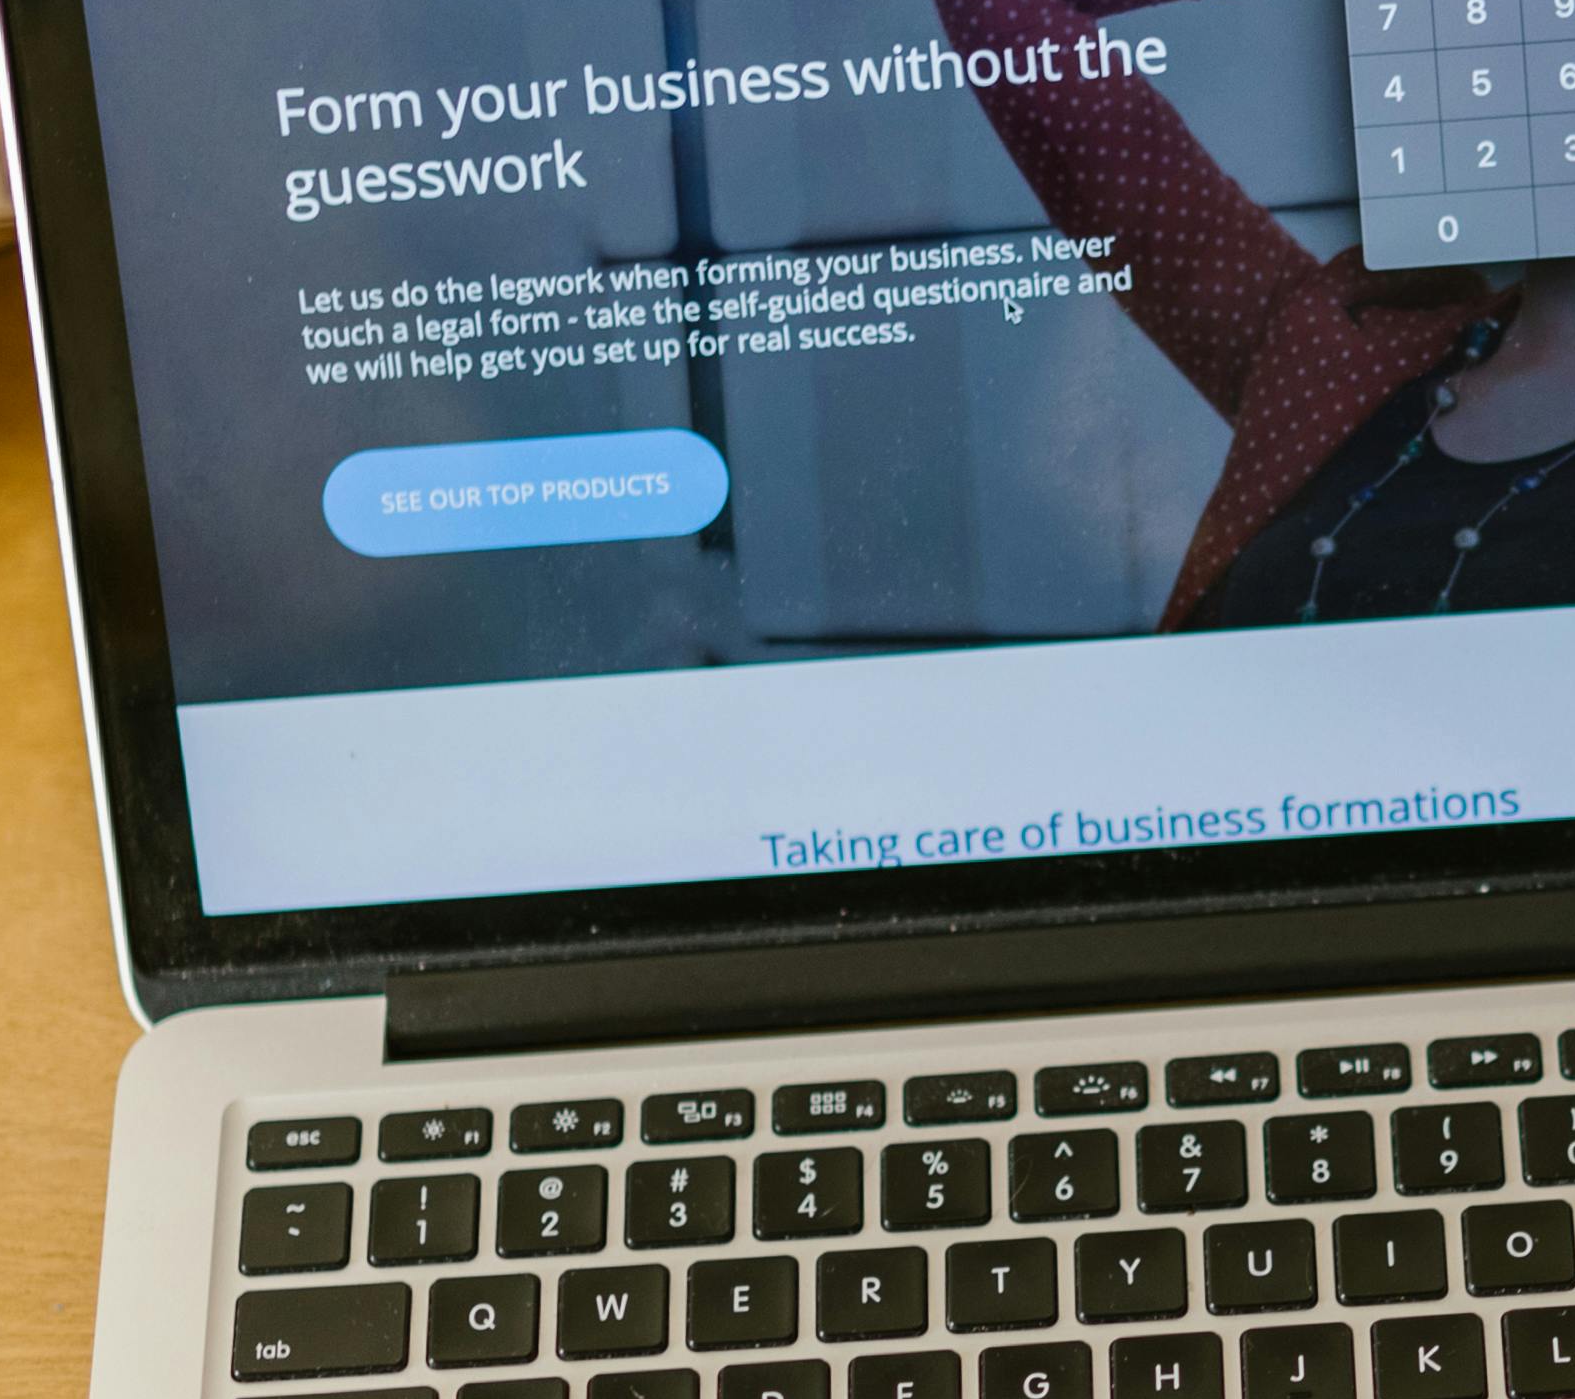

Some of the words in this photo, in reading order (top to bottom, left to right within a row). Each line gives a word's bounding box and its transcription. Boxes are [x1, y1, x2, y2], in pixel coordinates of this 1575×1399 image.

[1378, 3, 1398, 31] 7
[276, 87, 423, 137] Form
[436, 78, 568, 140] your
[583, 58, 830, 115] business
[842, 37, 1063, 96] without
[1074, 27, 1167, 79] the
[1383, 75, 1406, 102] 4
[1472, 68, 1492, 97] 5
[1390, 146, 1405, 174] 1
[1476, 140, 1497, 168] 2
[285, 138, 588, 222] guesswork
[1437, 215, 1459, 243] 0
[298, 287, 344, 315] Let
[350, 288, 385, 311] us
[391, 279, 429, 308] do
[434, 276, 483, 305] the
[490, 266, 605, 306] legwork
[609, 263, 689, 292] when
[696, 253, 813, 287] forming
[815, 252, 883, 285] your
[889, 242, 1024, 272] business.
[1030, 235, 1116, 262] Never
[301, 318, 384, 350] touch
[392, 322, 409, 344] a
[415, 310, 483, 347] legal
[489, 308, 560, 337] form
[584, 300, 647, 330] take
[652, 296, 701, 325] the
[708, 282, 865, 324] self-guided
[873, 271, 1070, 318] questionnaire
[1077, 264, 1132, 295] and
[305, 361, 348, 385] we
[353, 351, 403, 381] will
[409, 347, 473, 382] help
[480, 345, 527, 379] get
[530, 344, 585, 376] you
[592, 338, 637, 365] set
[643, 338, 681, 367] up
[687, 330, 731, 357] for
[737, 323, 791, 354] real
[798, 321, 916, 350] success.
[381, 490, 423, 514] SEE
[429, 486, 482, 510] OUR
[486, 482, 535, 506] TOP
[541, 472, 670, 502] PRODUCTS
[761, 830, 906, 873] Taking
[915, 826, 1005, 858] care
[1020, 811, 1063, 851] of
[1074, 809, 1268, 849] business
[1279, 786, 1521, 834] formations
[1382, 1067, 1401, 1081] F8
[1513, 1058, 1532, 1072] F9
[1119, 1086, 1138, 1100] F6
[1251, 1077, 1269, 1091] F7
[855, 1104, 874, 1118] F4
[988, 1094, 1006, 1109] F5
[593, 1121, 611, 1136] F2
[724, 1112, 743, 1127] F3
[285, 1130, 321, 1147] esc
[464, 1130, 480, 1145] F1
[1506, 1231, 1534, 1258] O
[1119, 1257, 1141, 1285] Y
[1247, 1249, 1273, 1277] U
[861, 1276, 881, 1304] R
[991, 1266, 1011, 1294] T
[595, 1292, 629, 1322] W
[733, 1285, 750, 1313] E
[468, 1303, 496, 1331] Q
[255, 1339, 291, 1360] tab
[1418, 1345, 1442, 1373] K
[1552, 1336, 1572, 1364] L
[1155, 1362, 1180, 1392] H
[1289, 1354, 1305, 1383] J
[1022, 1372, 1050, 1399] G
